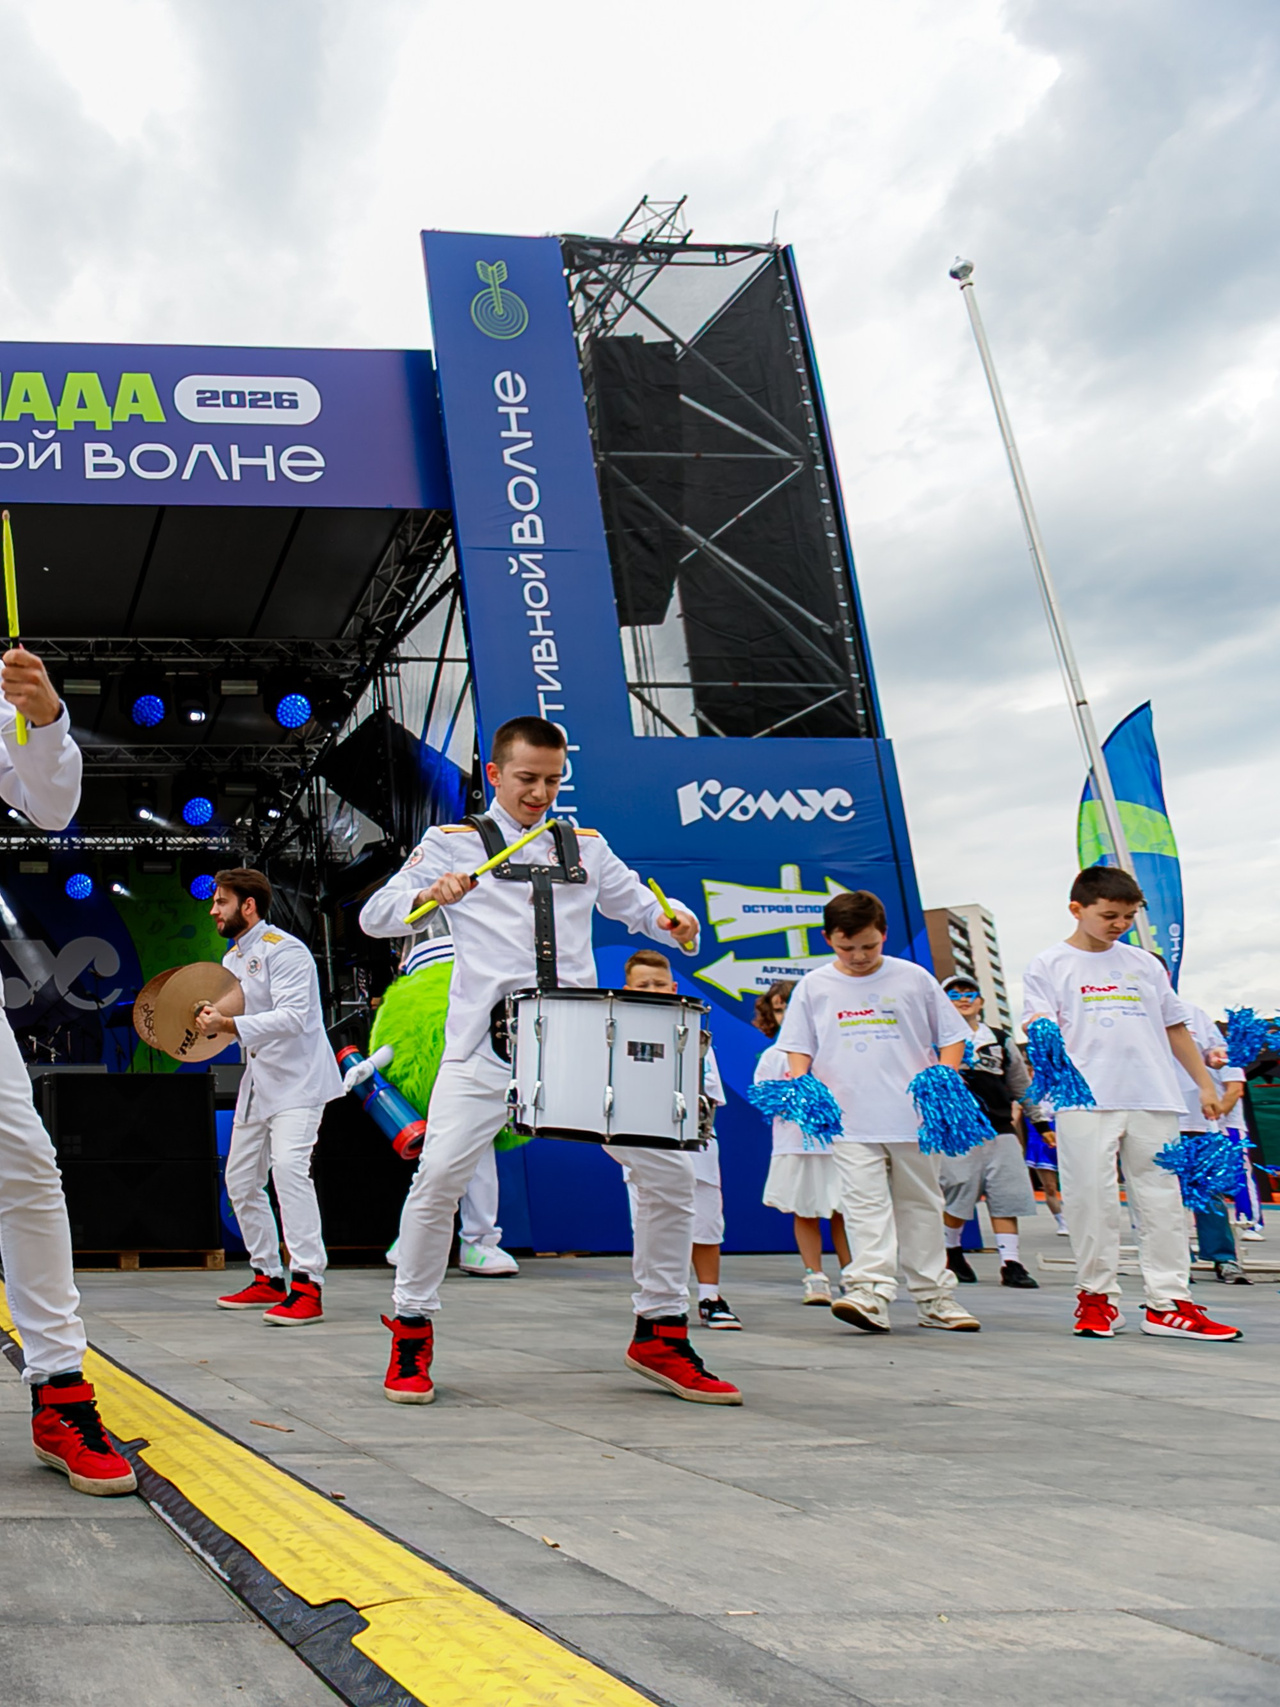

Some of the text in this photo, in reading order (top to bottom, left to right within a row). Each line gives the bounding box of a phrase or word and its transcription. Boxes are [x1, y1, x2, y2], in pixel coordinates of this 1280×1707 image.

[195, 388, 300, 409] 2026
[84, 442, 326, 483] волне
[494, 370, 546, 545] волне
[742, 904, 794, 914] ОСТРОВ
